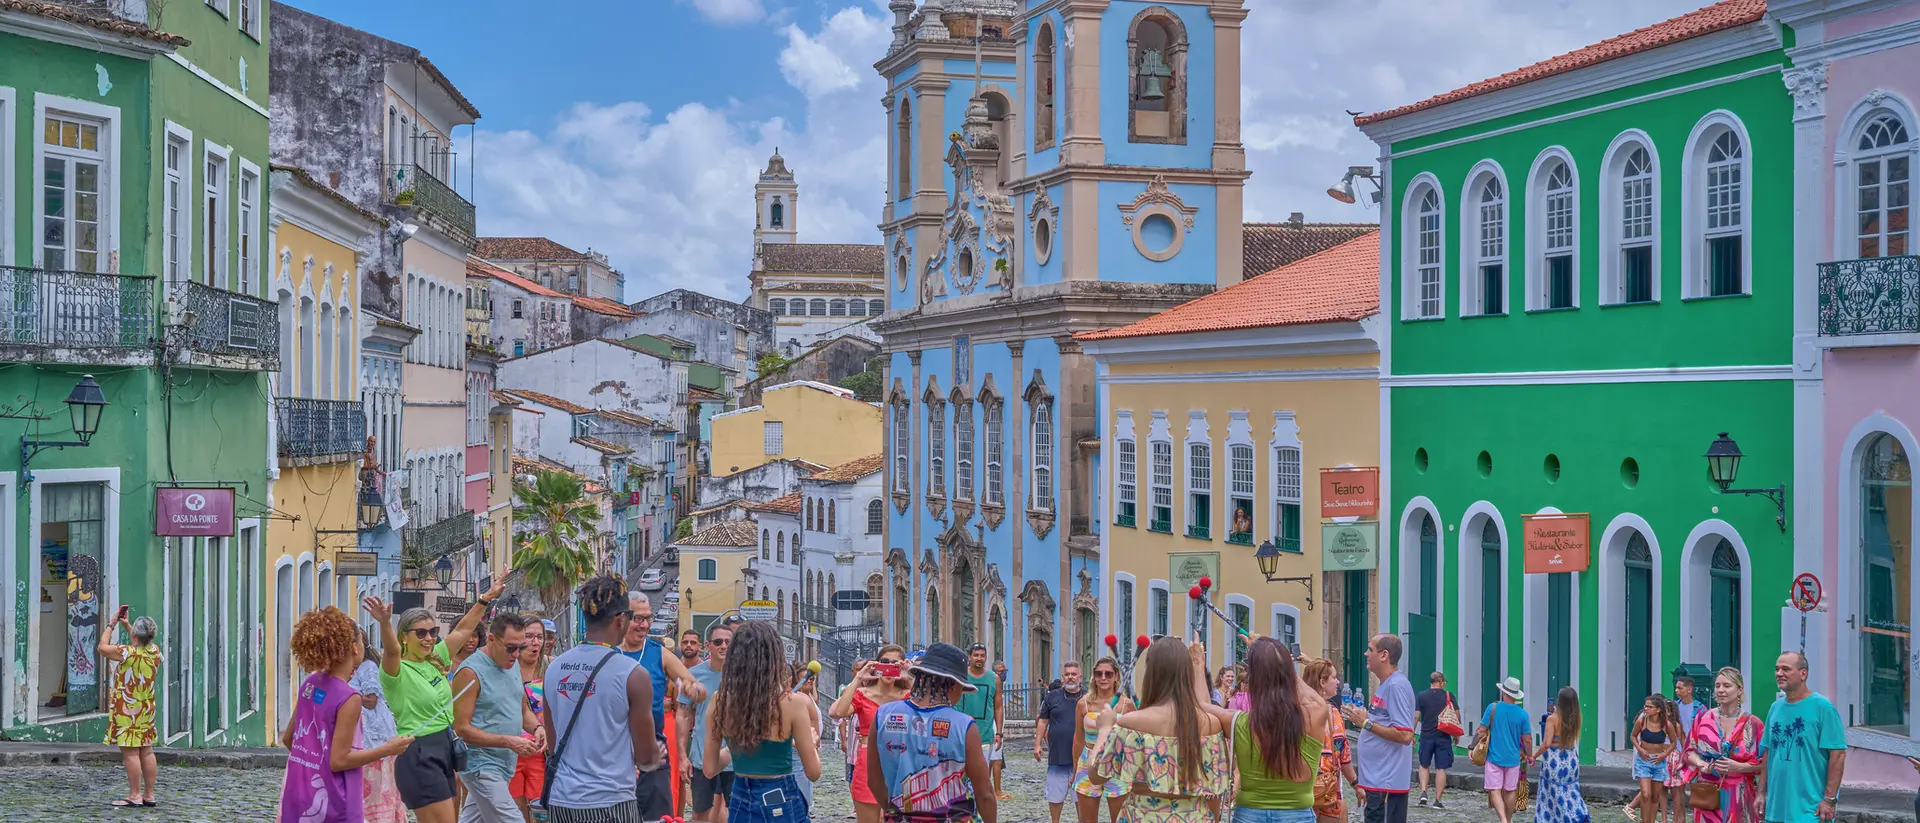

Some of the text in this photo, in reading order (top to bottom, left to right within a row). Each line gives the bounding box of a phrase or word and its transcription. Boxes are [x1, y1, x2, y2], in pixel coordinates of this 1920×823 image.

[1331, 481, 1364, 495] Teatro
[172, 514, 219, 523] CASA DA PONTE
[1533, 527, 1576, 538] Restaurante
[1562, 539, 1583, 549] Sabor
[560, 662, 596, 671] World Tea
